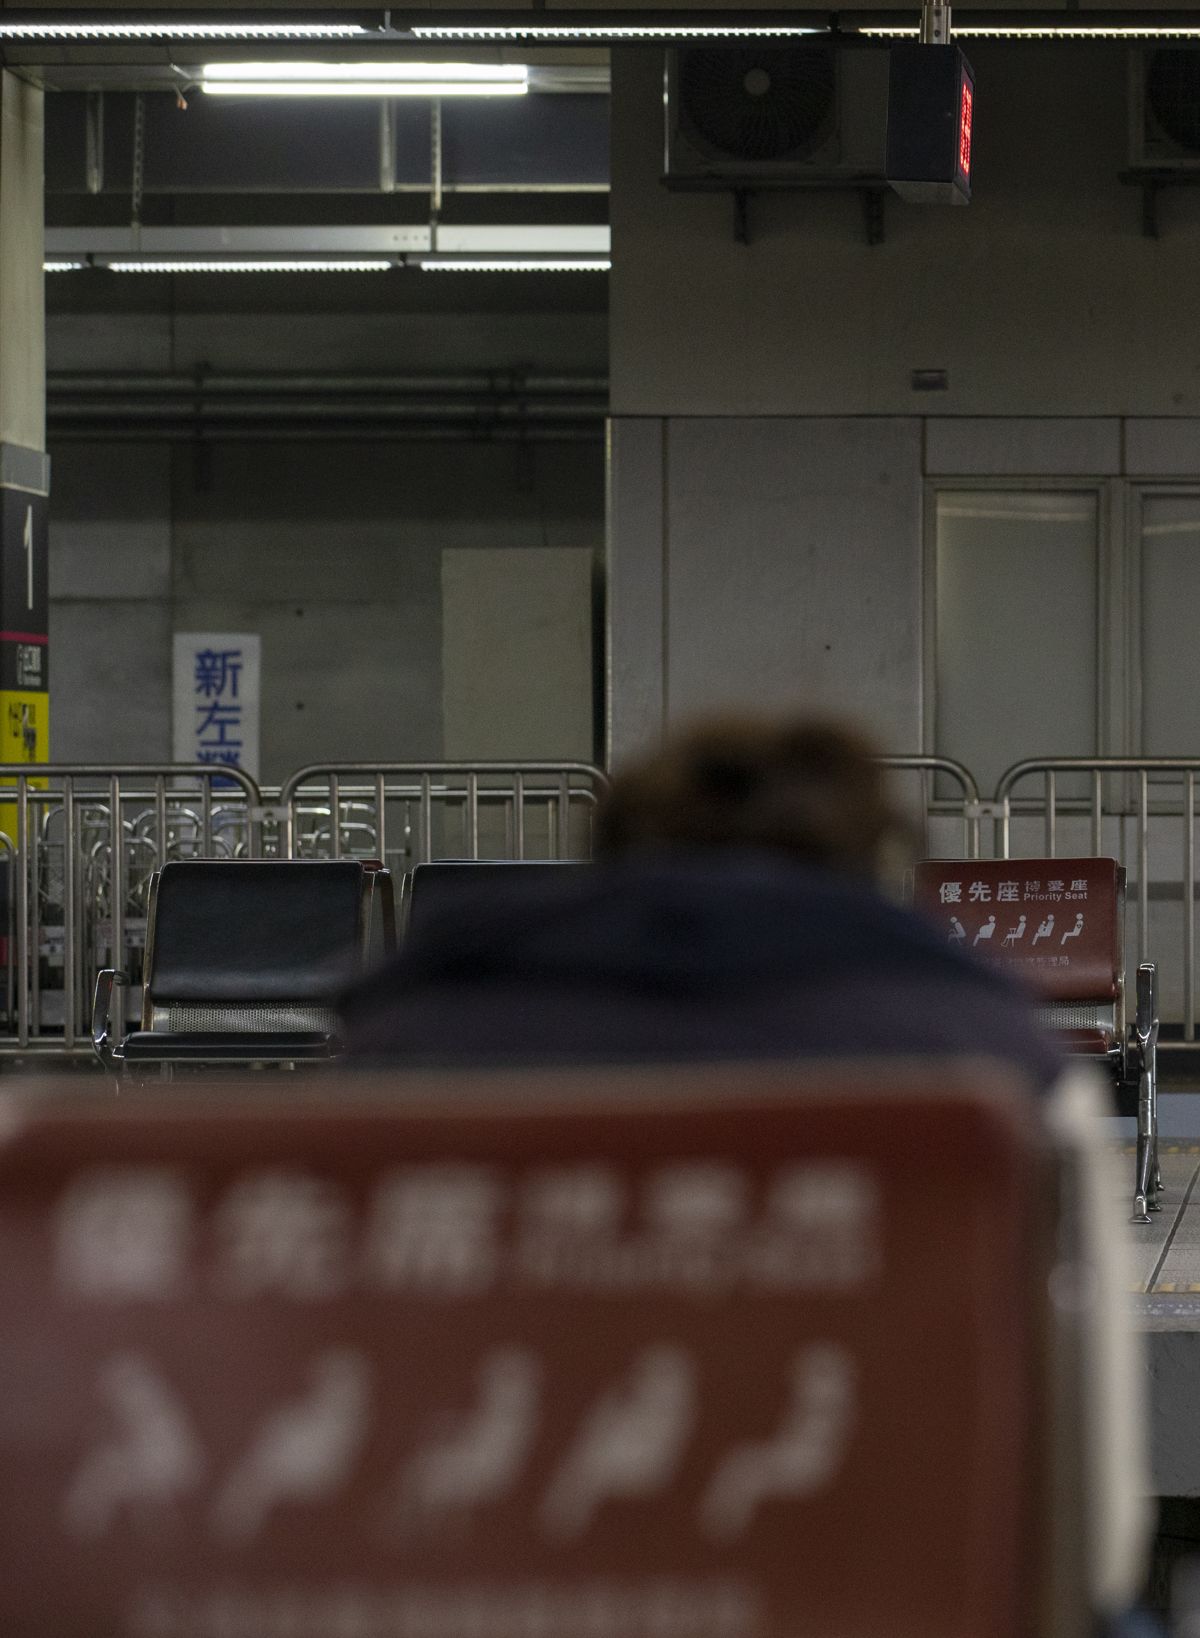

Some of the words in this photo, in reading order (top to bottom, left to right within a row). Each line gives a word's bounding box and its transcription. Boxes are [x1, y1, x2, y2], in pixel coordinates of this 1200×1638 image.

[939, 880, 1020, 903] 優先座
[1024, 879, 1088, 892] 博愛座
[1023, 892, 1062, 903] Priority
[1064, 891, 1088, 901] Seat
